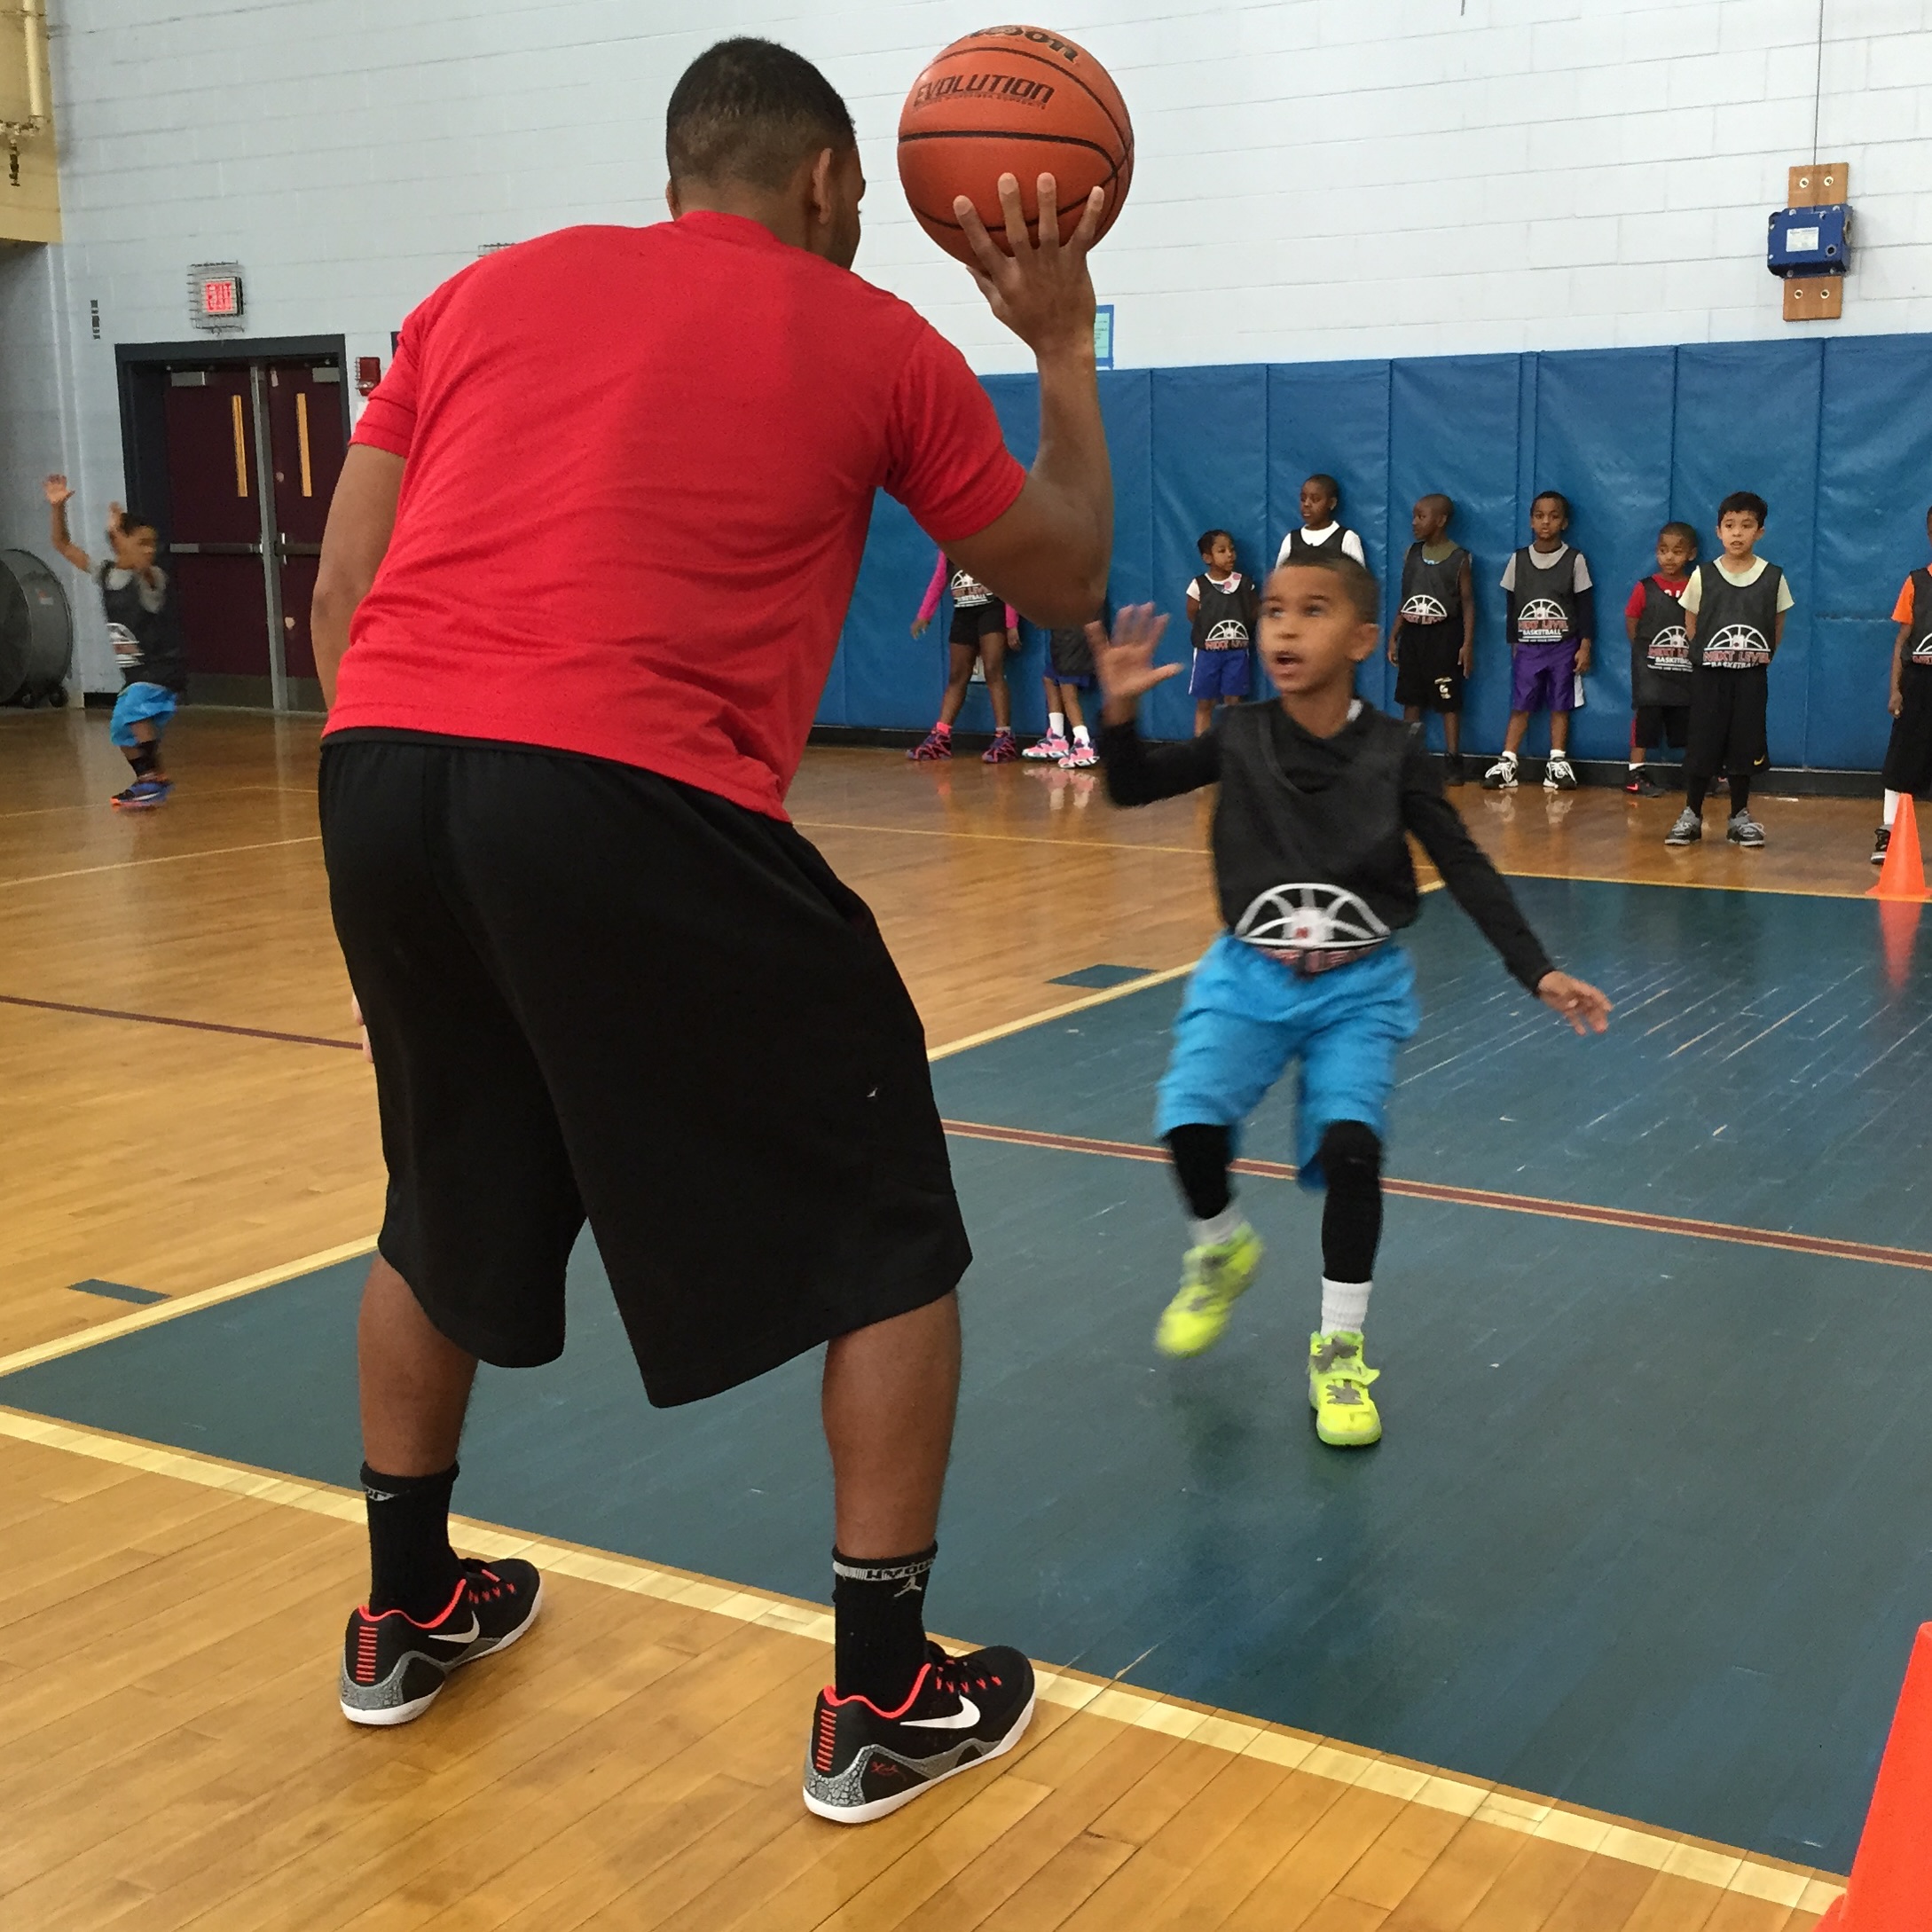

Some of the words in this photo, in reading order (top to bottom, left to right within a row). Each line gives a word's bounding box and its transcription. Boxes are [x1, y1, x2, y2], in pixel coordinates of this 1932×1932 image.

[914, 74, 1055, 107] EVOLUTION
[1703, 650, 1735, 662] NEXT
[1739, 651, 1771, 664] LEVEL
